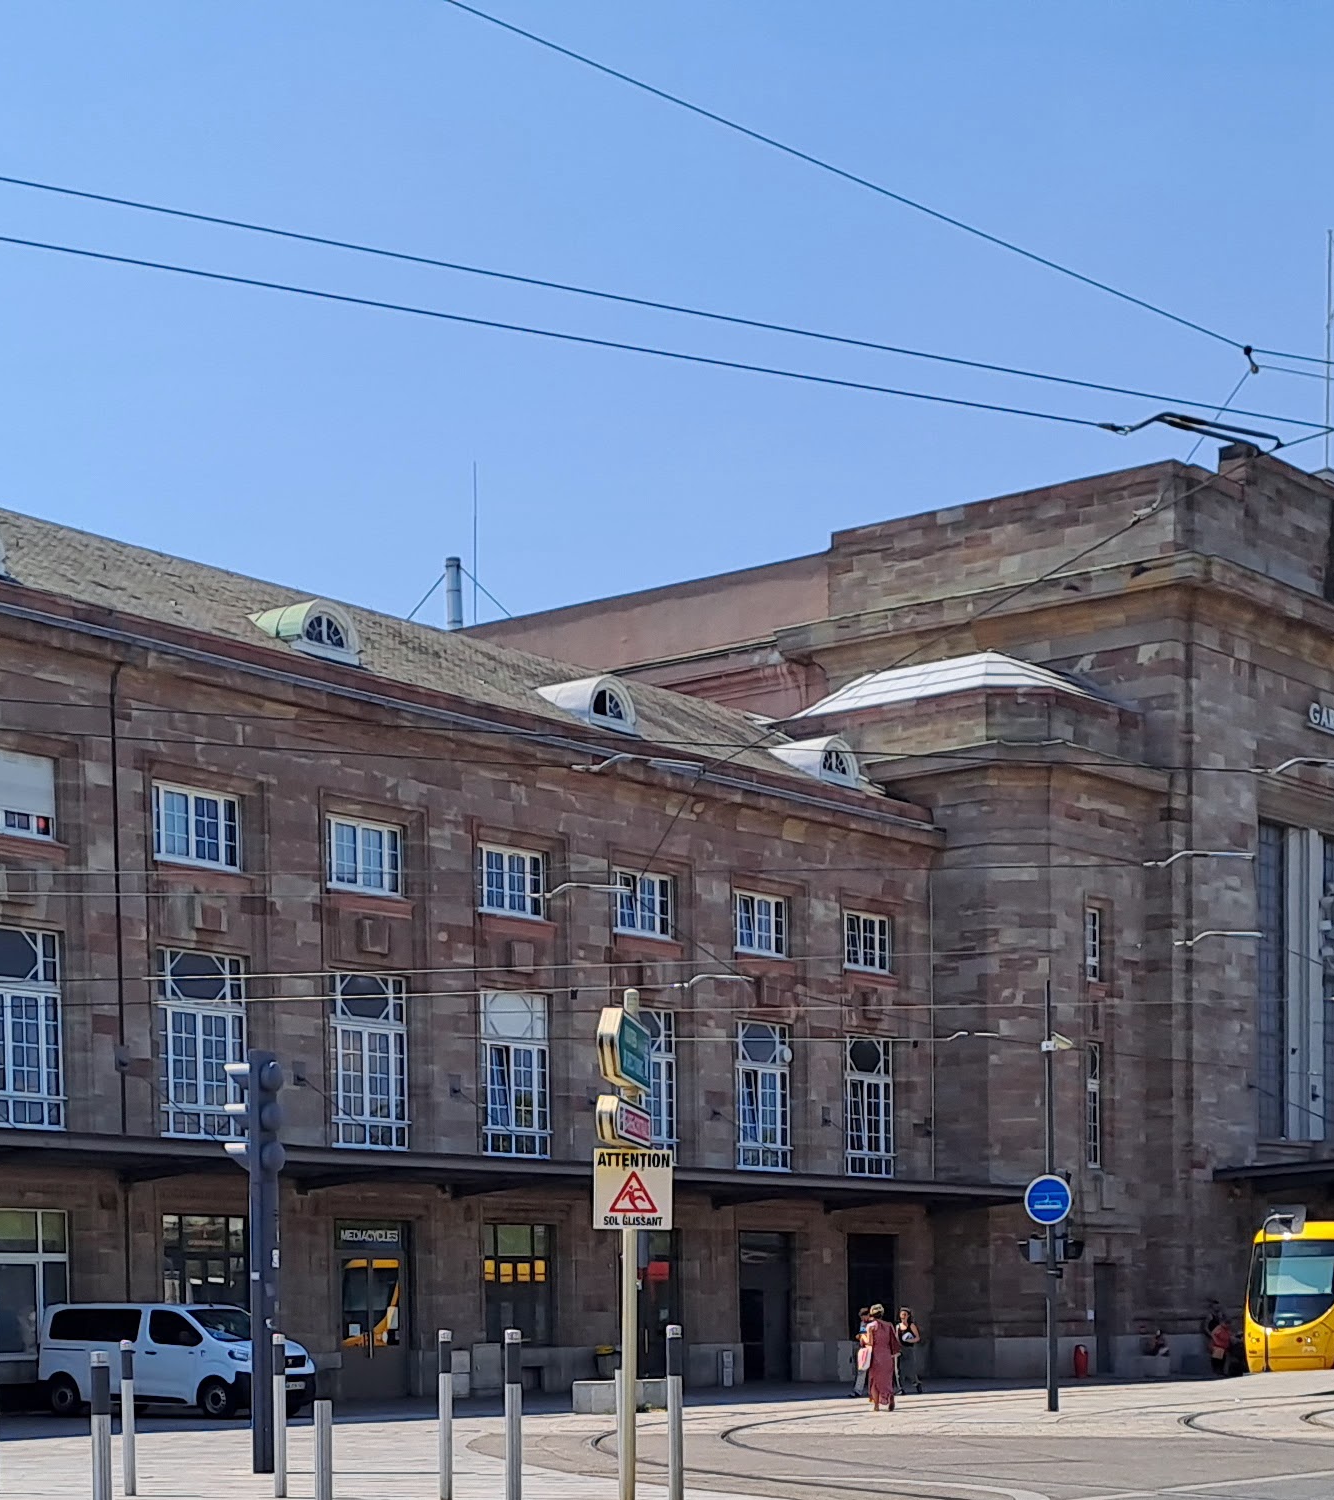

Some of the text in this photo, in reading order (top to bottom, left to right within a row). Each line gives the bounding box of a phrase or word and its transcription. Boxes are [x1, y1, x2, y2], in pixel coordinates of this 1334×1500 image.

[597, 1152, 670, 1168] ATTENTION
[603, 1216, 663, 1227] SOL GLISSANT
[340, 1229, 399, 1242] MEDIACYCLES
